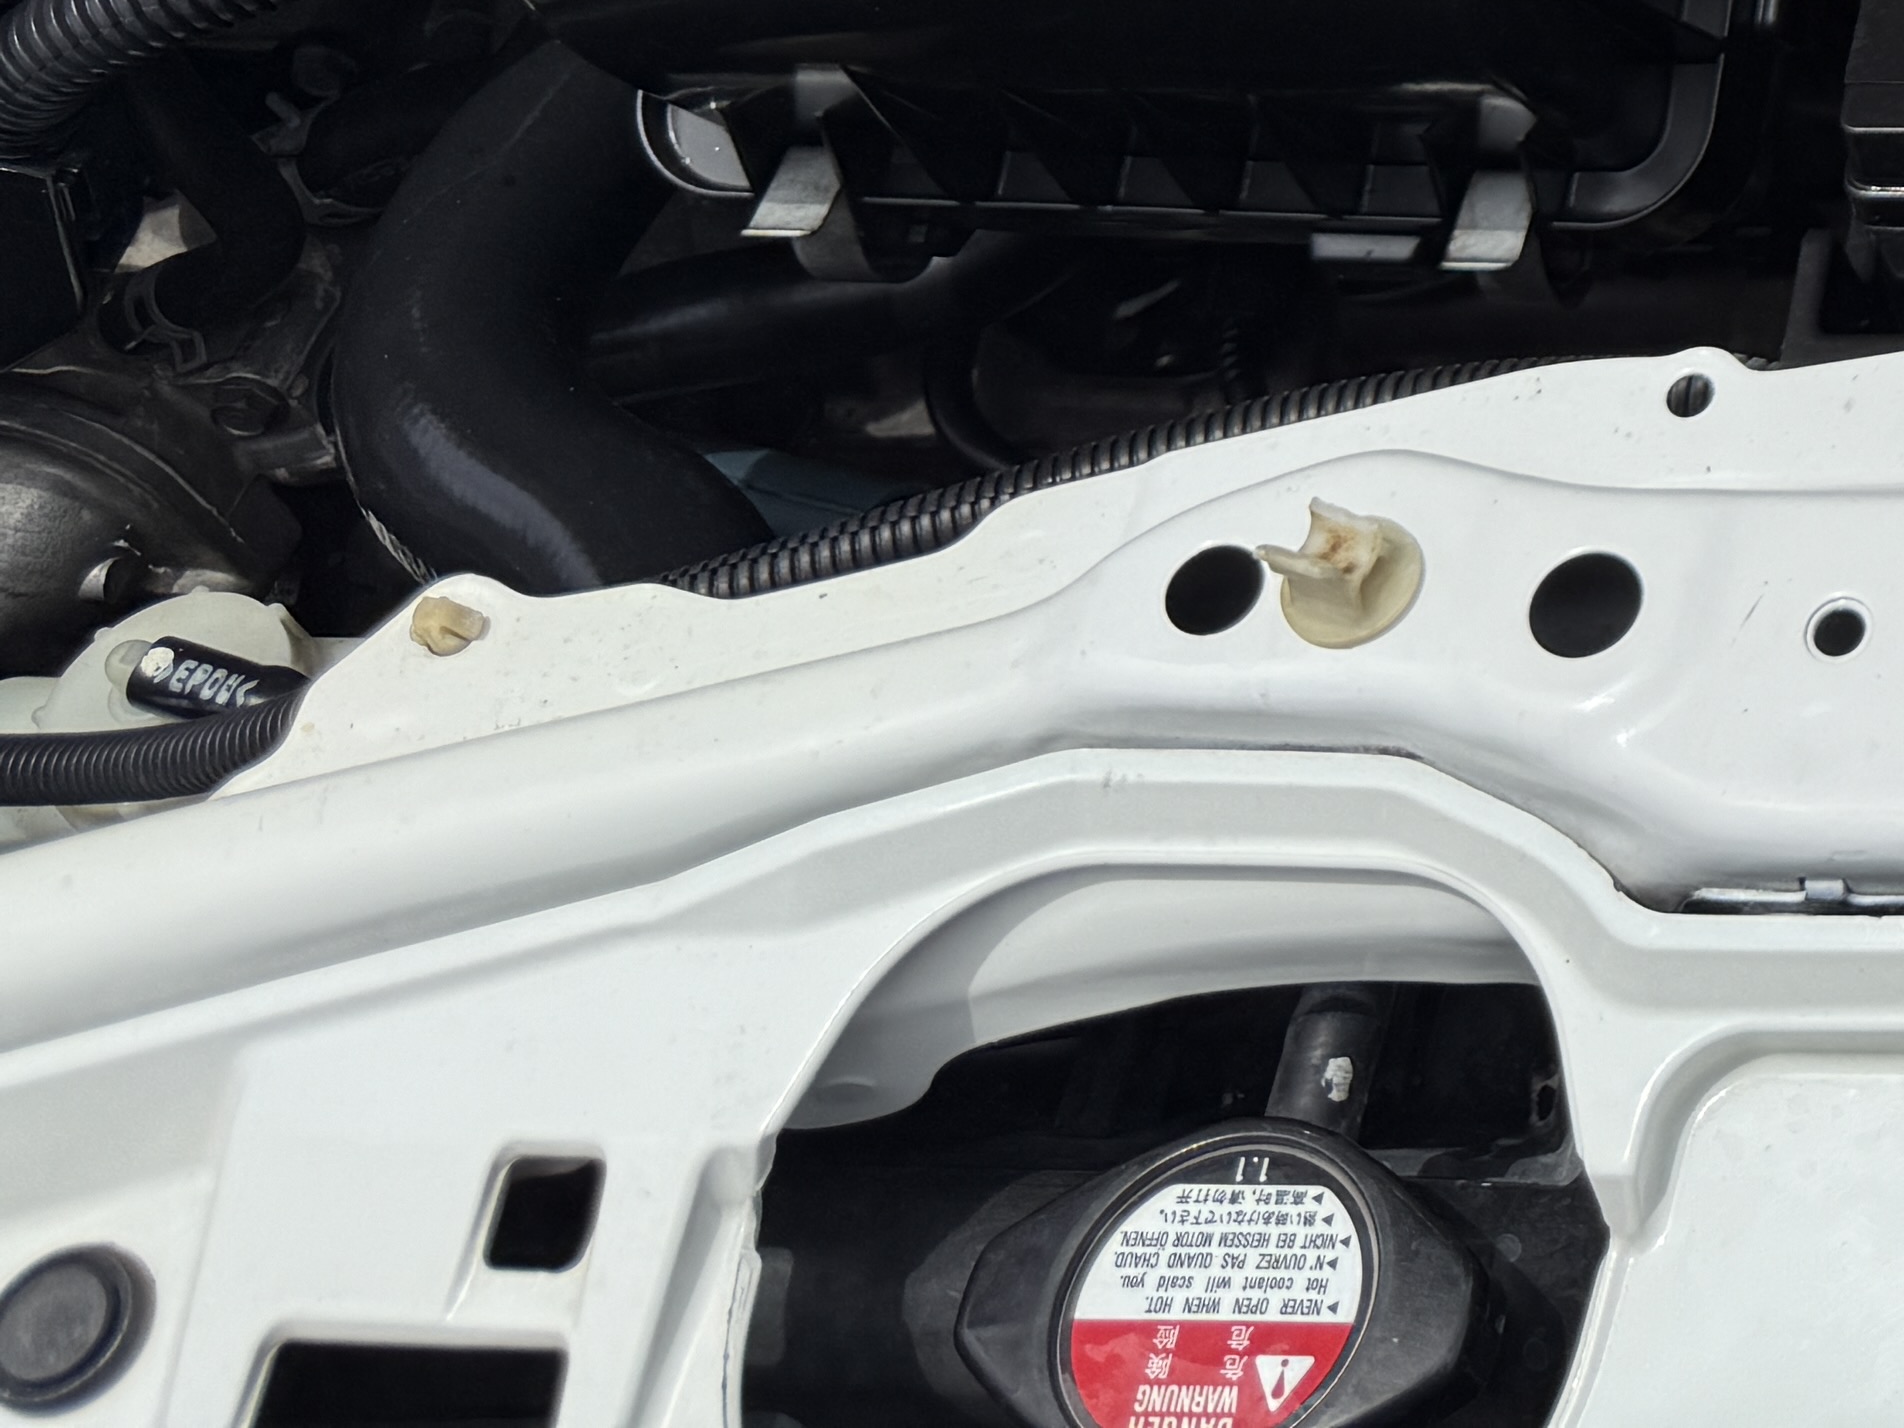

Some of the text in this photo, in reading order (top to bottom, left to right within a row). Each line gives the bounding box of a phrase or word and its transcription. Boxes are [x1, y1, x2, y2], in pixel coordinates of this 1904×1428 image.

[1235, 1156, 1270, 1183] 1.1
[1120, 1230, 1338, 1252] NICHT BEI HEISSEM MOTOR ÖFFNEN.
[1114, 1251, 1160, 1269] CHAUD.
[1167, 1252, 1213, 1269] QUAND
[1222, 1253, 1247, 1269] PAS
[1256, 1254, 1307, 1270] OUVREZ
[1120, 1272, 1329, 1295] Hot coolant will scald you.
[1144, 1296, 1324, 1316] NEVER OPEN WHEN HOT.
[1227, 1326, 1254, 1350] 危
[1220, 1354, 1248, 1380] 危
[1134, 1384, 1238, 1414] WARNUNG
